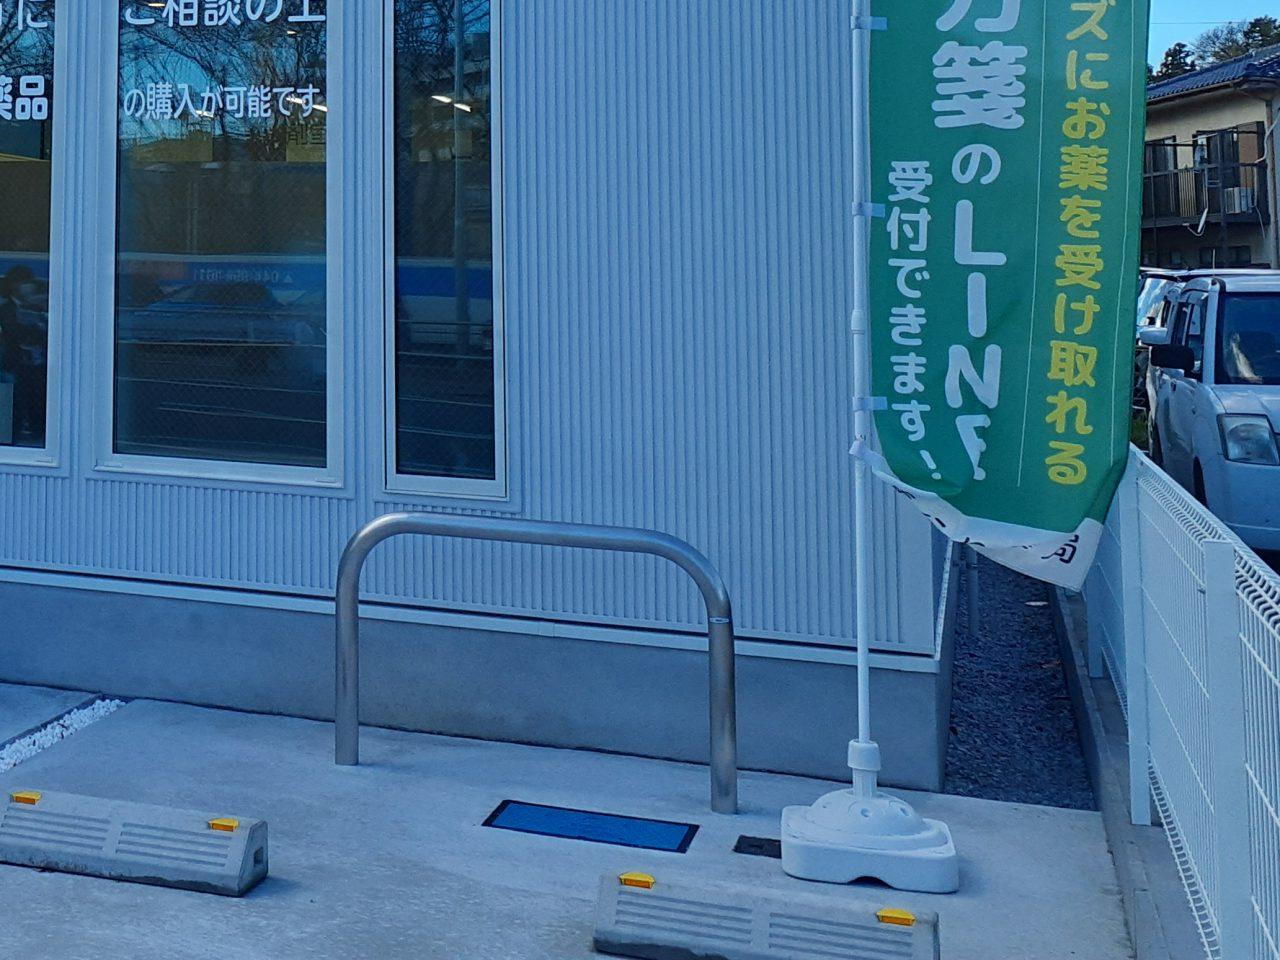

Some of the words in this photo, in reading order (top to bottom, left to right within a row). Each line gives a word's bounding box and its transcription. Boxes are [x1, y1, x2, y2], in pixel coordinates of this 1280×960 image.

[124, 82, 321, 120] の購入が可能です
